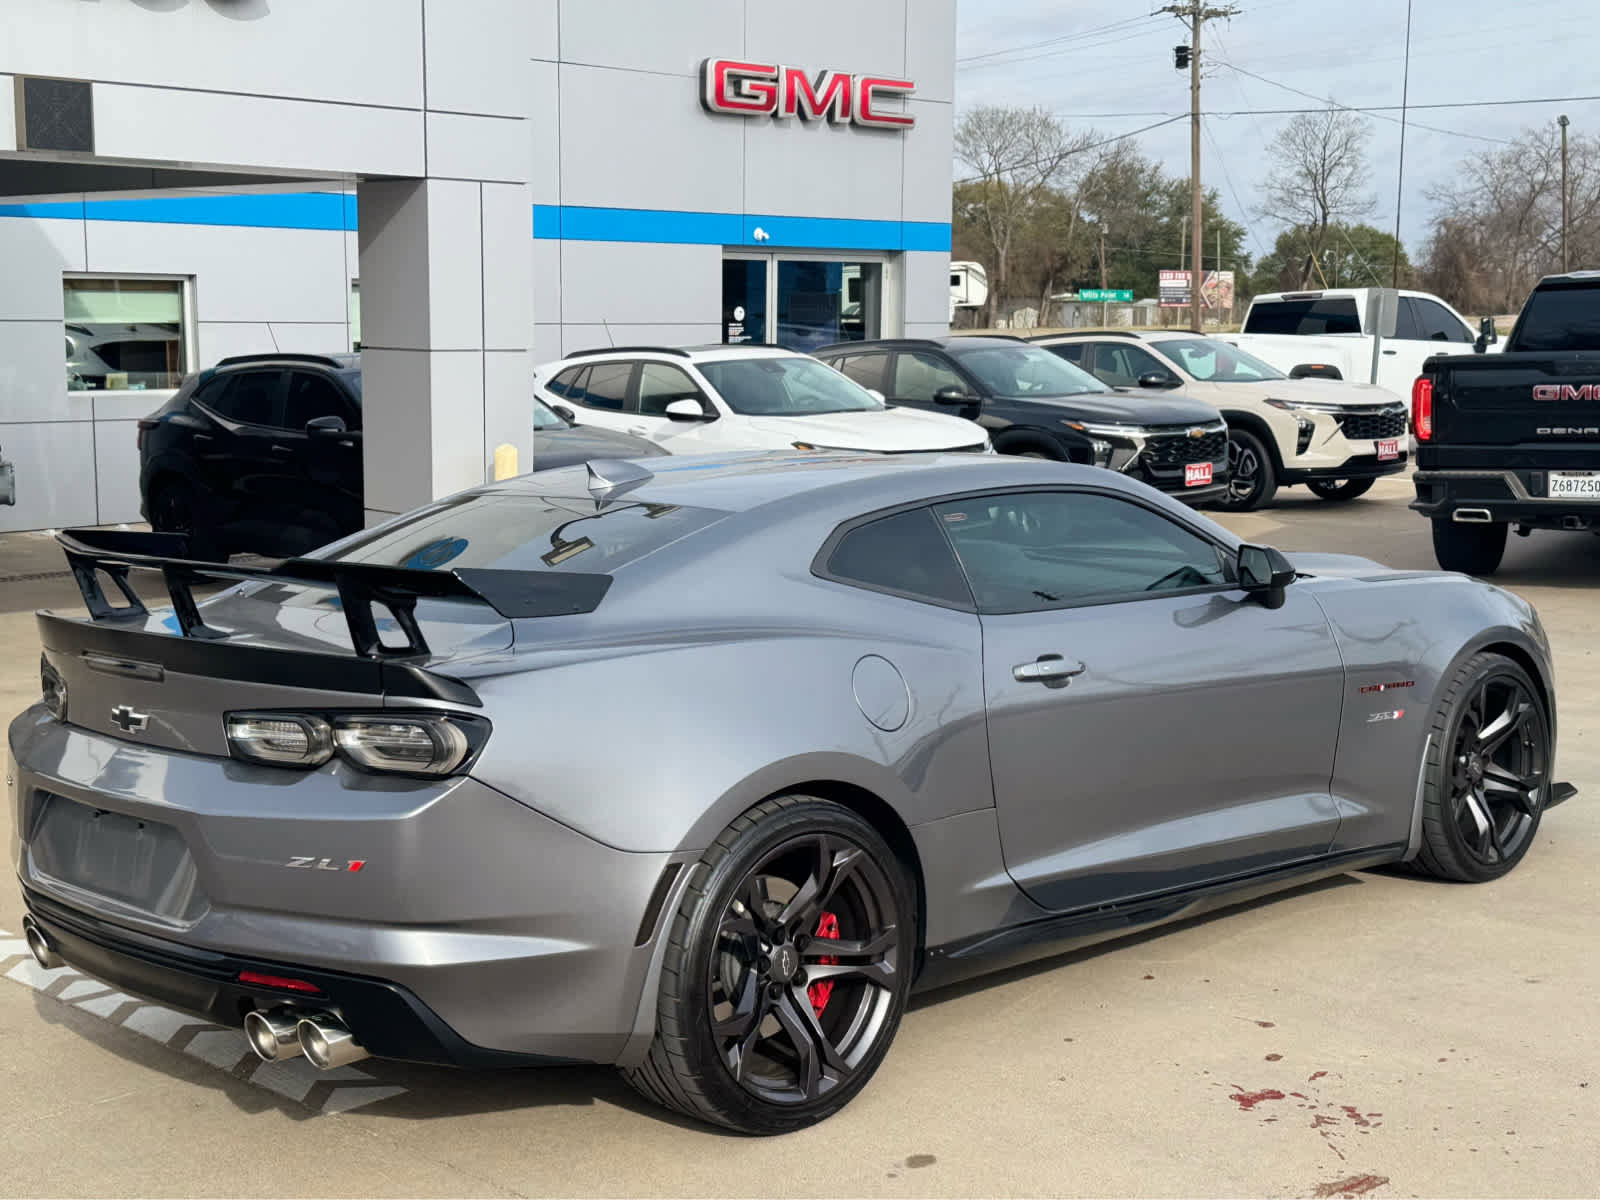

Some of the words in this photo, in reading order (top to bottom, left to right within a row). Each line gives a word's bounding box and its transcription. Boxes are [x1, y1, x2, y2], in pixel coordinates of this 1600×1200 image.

[701, 57, 916, 130] GMC
[1378, 442, 1398, 456] HALL
[1186, 467, 1211, 480] HALL
[1552, 479, 1600, 492] Z687250
[285, 856, 367, 872] ZL1
